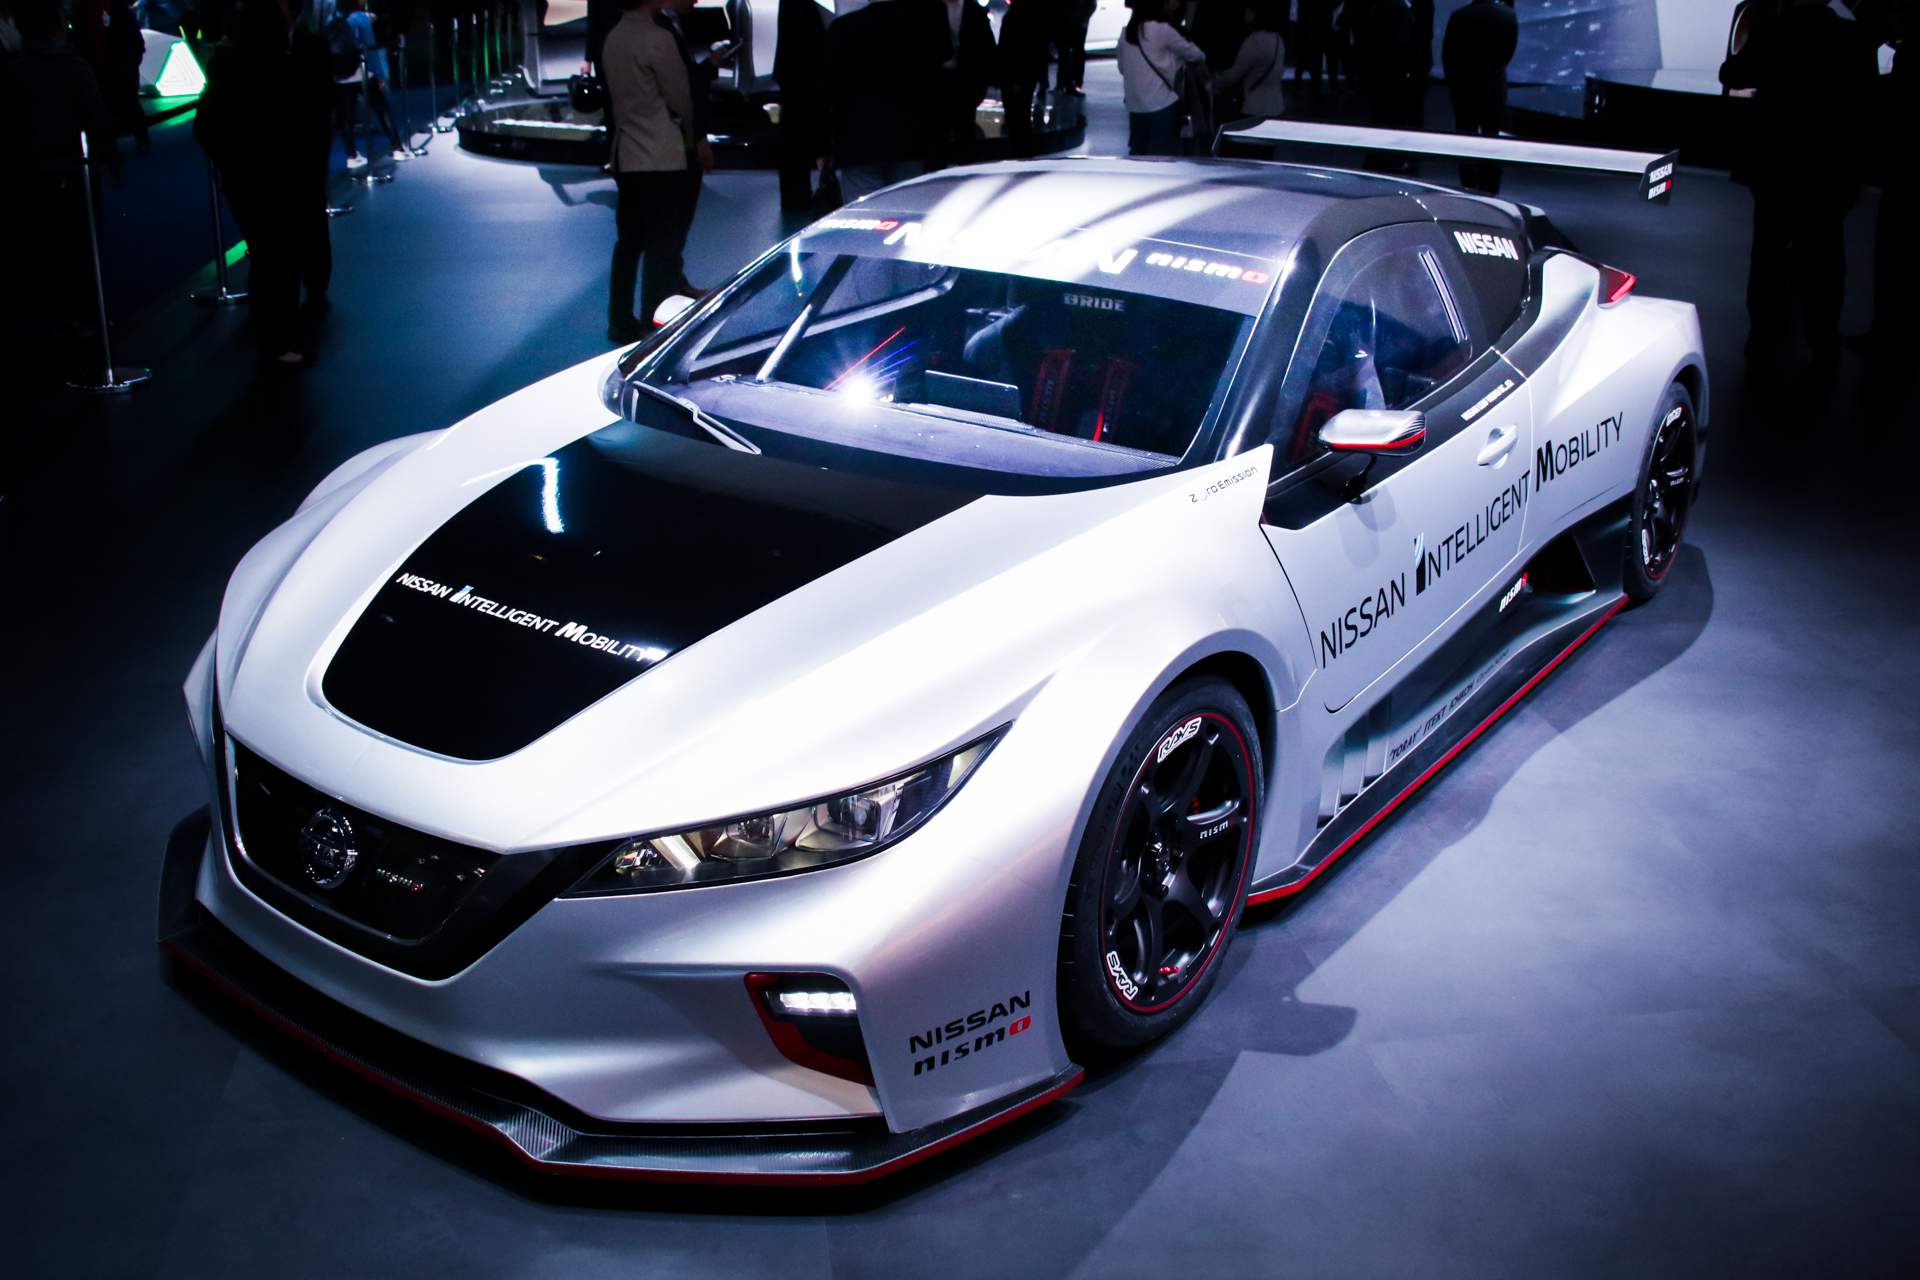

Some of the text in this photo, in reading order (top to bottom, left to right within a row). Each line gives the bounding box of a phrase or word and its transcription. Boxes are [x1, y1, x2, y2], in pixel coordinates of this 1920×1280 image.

[1453, 231, 1519, 261] NISSAN
[1063, 292, 1126, 312] BRIDE
[1217, 466, 1259, 489] Emission
[1319, 411, 1624, 669] NISSAN INTELLIGENT MOBILITY
[396, 572, 453, 598] NISSAN
[449, 585, 559, 633] INTELLIGENT
[1157, 716, 1202, 764] RAYS
[1105, 951, 1138, 1001] RAYS
[909, 990, 1031, 1054] NISSAN
